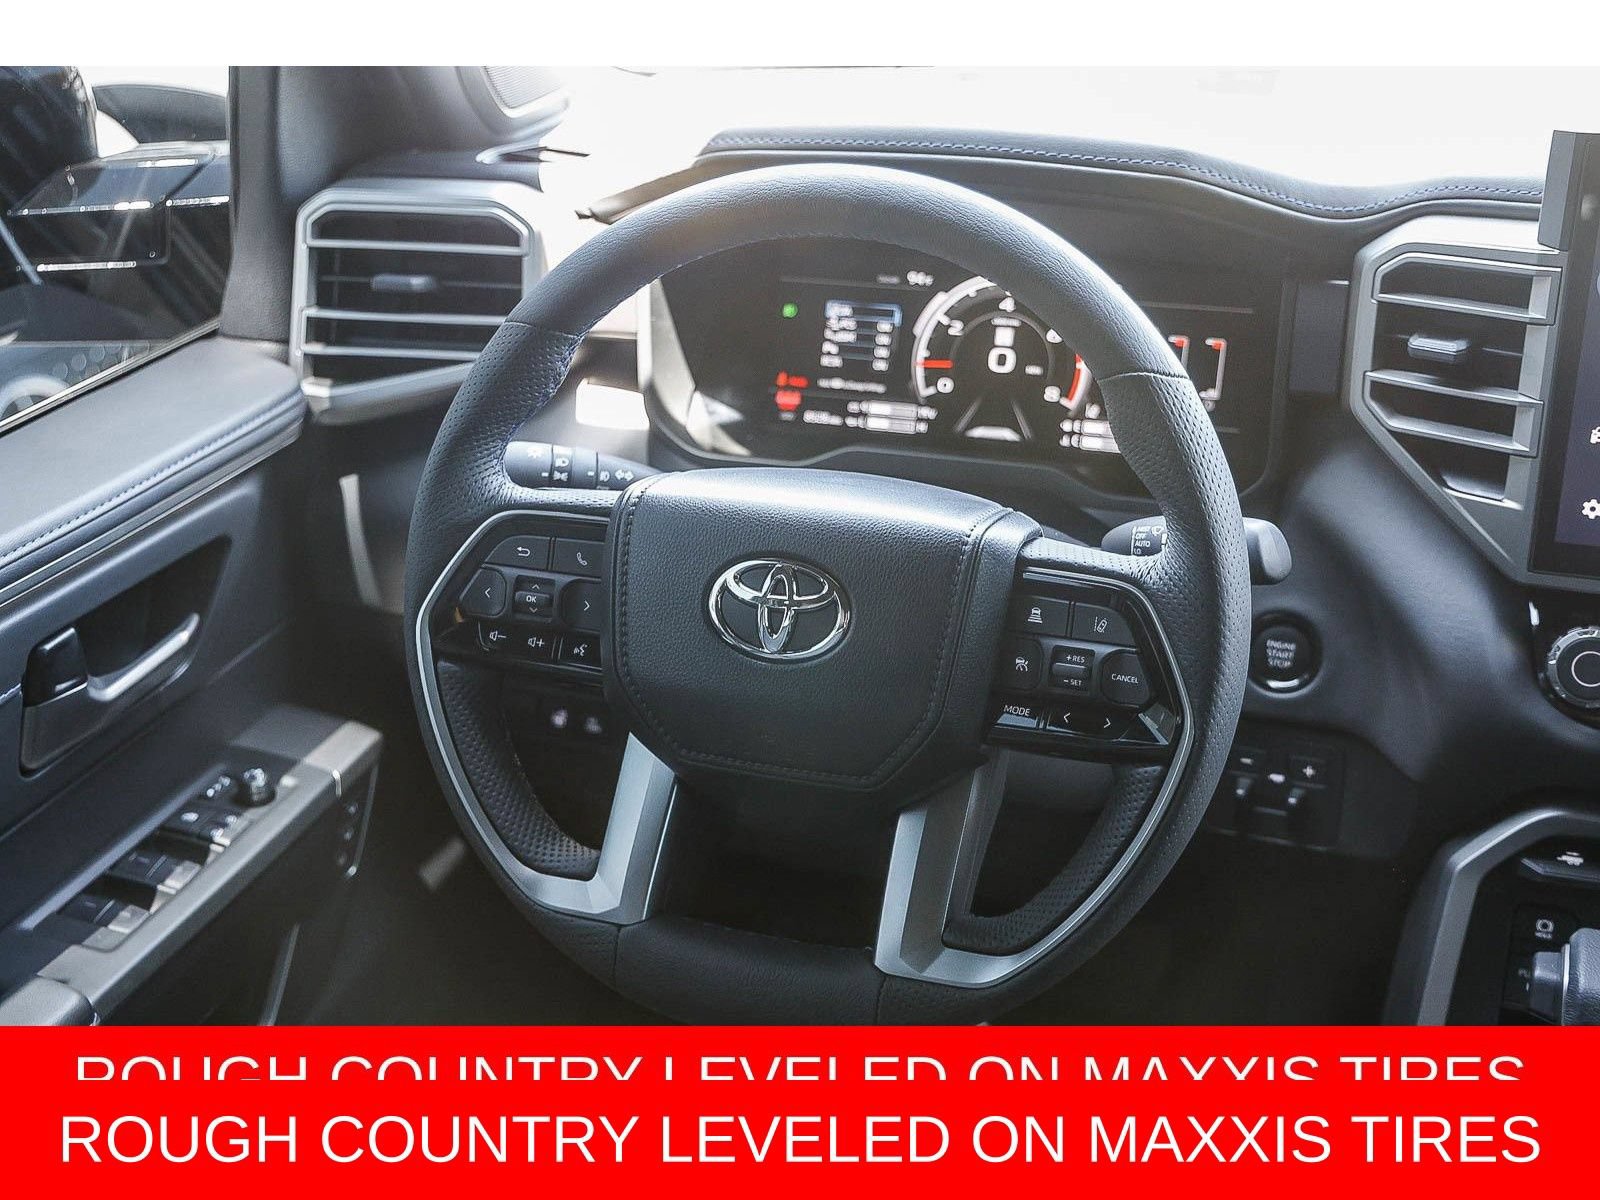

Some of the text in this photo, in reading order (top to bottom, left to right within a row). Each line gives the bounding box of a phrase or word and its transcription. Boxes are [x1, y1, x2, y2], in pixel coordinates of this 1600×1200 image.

[948, 319, 965, 335] 2
[988, 347, 1017, 375] 0
[936, 377, 955, 394] 0
[1043, 385, 1061, 402] 8
[526, 595, 537, 603] OK
[1266, 639, 1296, 651] ENGINE
[1266, 649, 1295, 659] START
[1111, 673, 1139, 684] CANCEL
[1003, 704, 1031, 717] MODE
